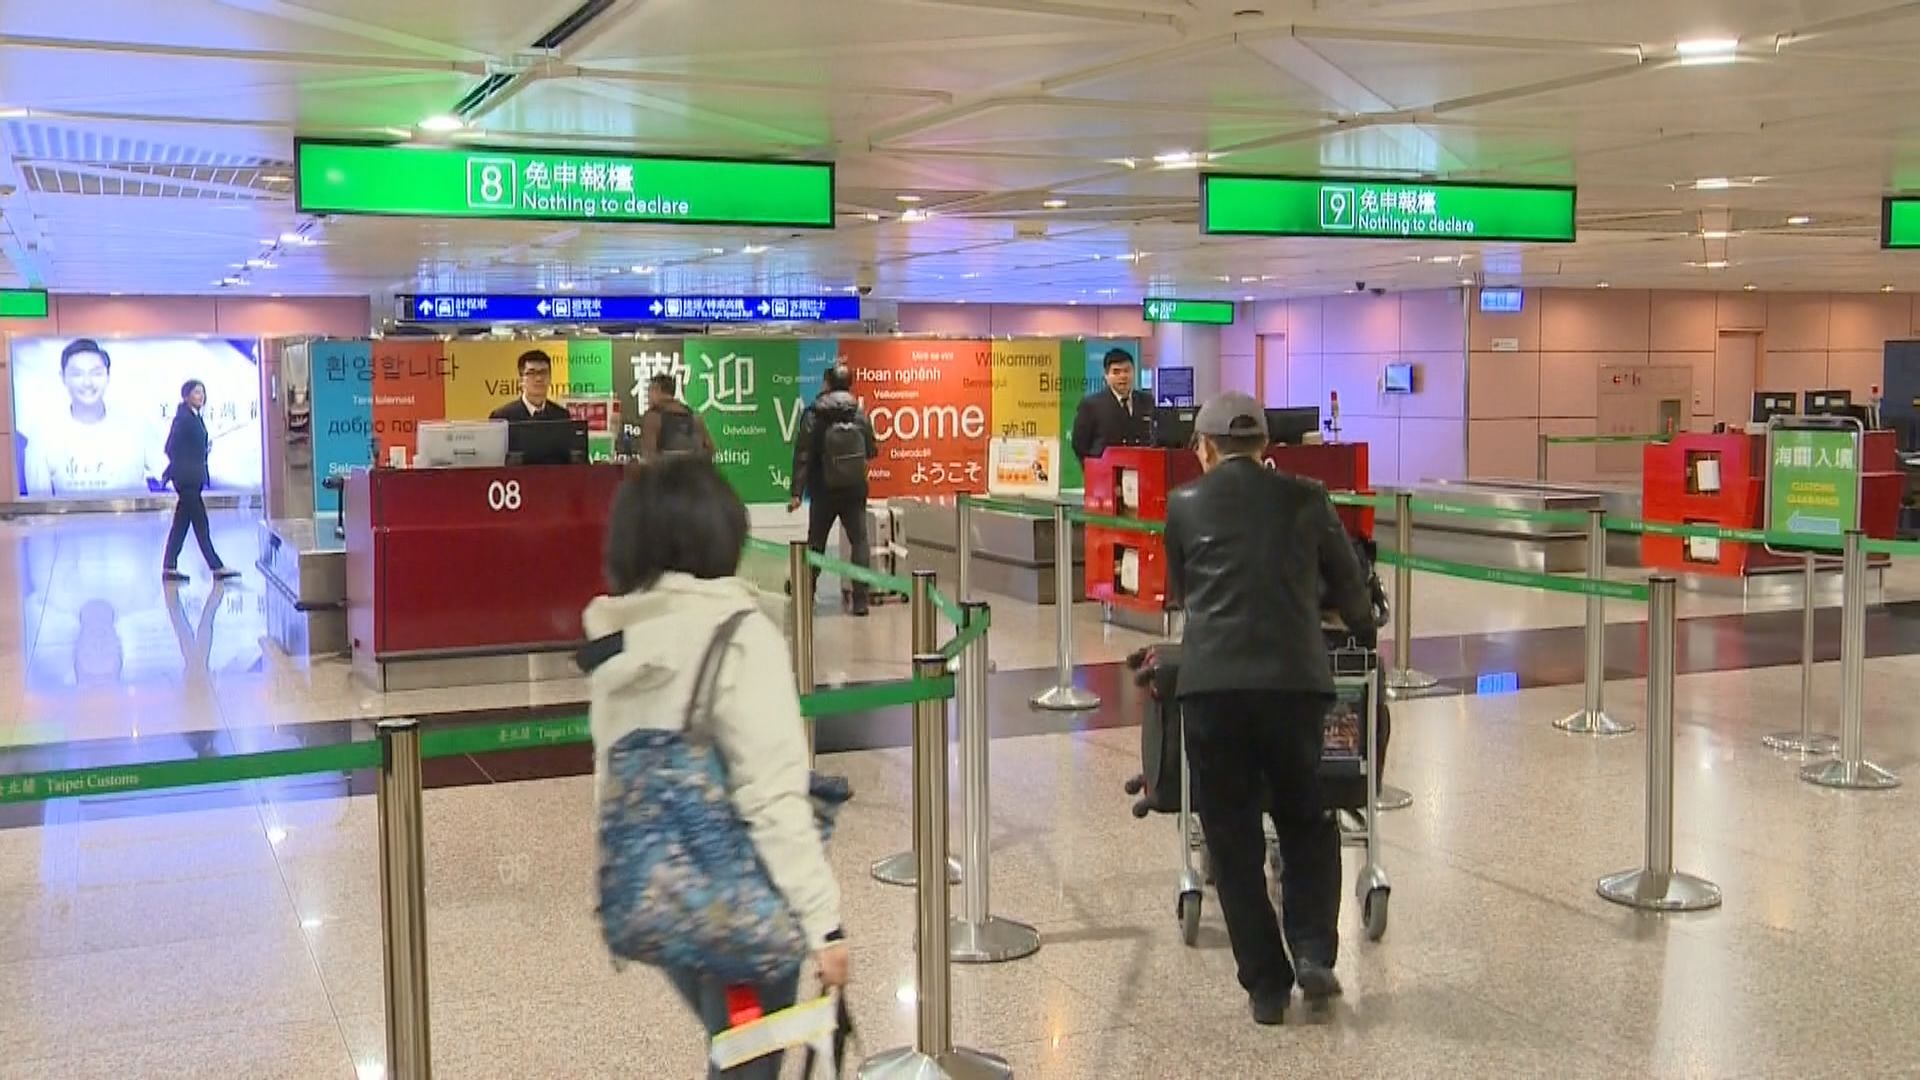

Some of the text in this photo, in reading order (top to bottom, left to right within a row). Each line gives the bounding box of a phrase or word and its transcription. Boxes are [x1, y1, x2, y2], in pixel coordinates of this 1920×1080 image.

[481, 165, 503, 202] 8
[522, 192, 689, 215] Nothing to declare
[1330, 193, 1346, 224] 9
[1359, 214, 1474, 234] Nothing to declare
[327, 353, 460, 382] 환영합니다
[975, 351, 1052, 367] Willkommen
[856, 366, 941, 384] Hoan nghênh
[485, 378, 596, 396] Välkmmen
[328, 415, 385, 437] добро
[911, 462, 983, 484] ようこそ
[488, 480, 522, 510] 08
[47, 776, 84, 794] Taipei
[87, 773, 140, 789] Customs
